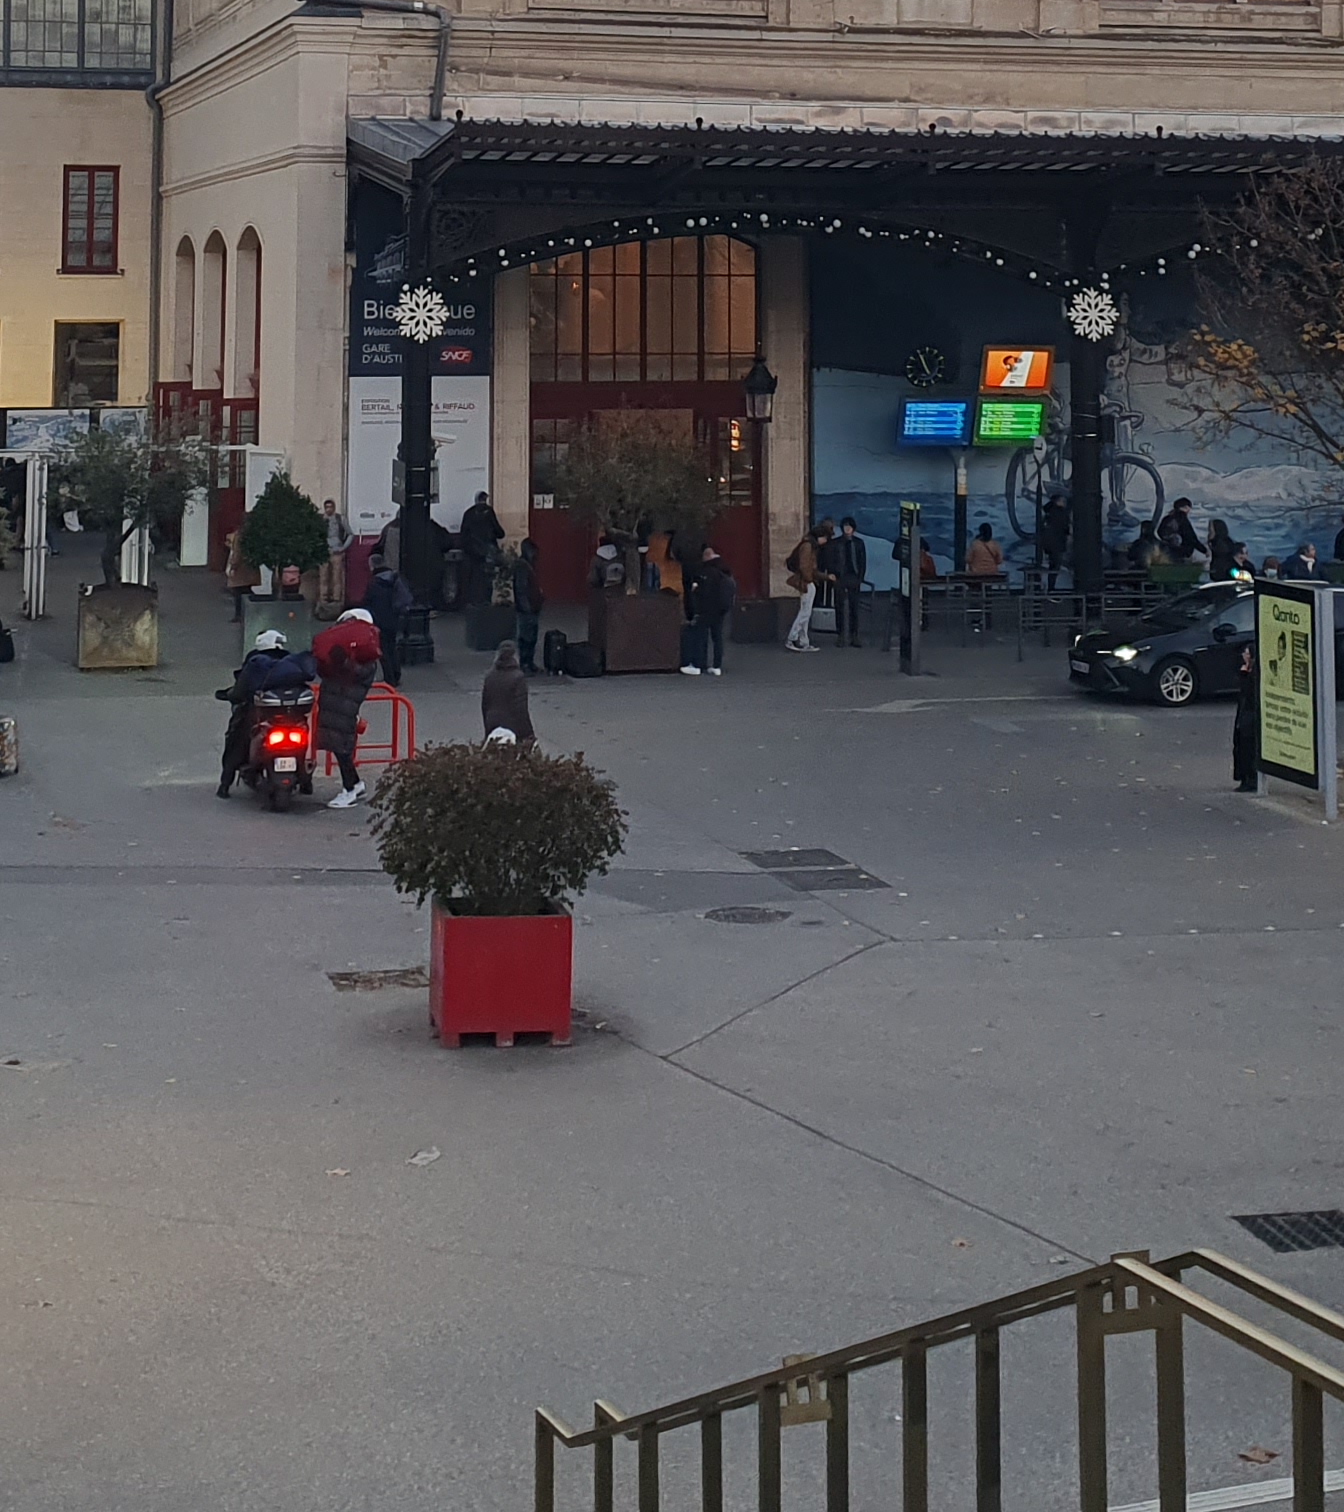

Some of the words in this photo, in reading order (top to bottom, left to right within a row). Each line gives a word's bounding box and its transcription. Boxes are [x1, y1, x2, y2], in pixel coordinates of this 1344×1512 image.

[363, 299, 476, 320] Bieue
[443, 326, 476, 336] venido
[362, 343, 391, 354] GARE
[439, 350, 473, 361] SNCF
[1272, 603, 1300, 625] Qonto
